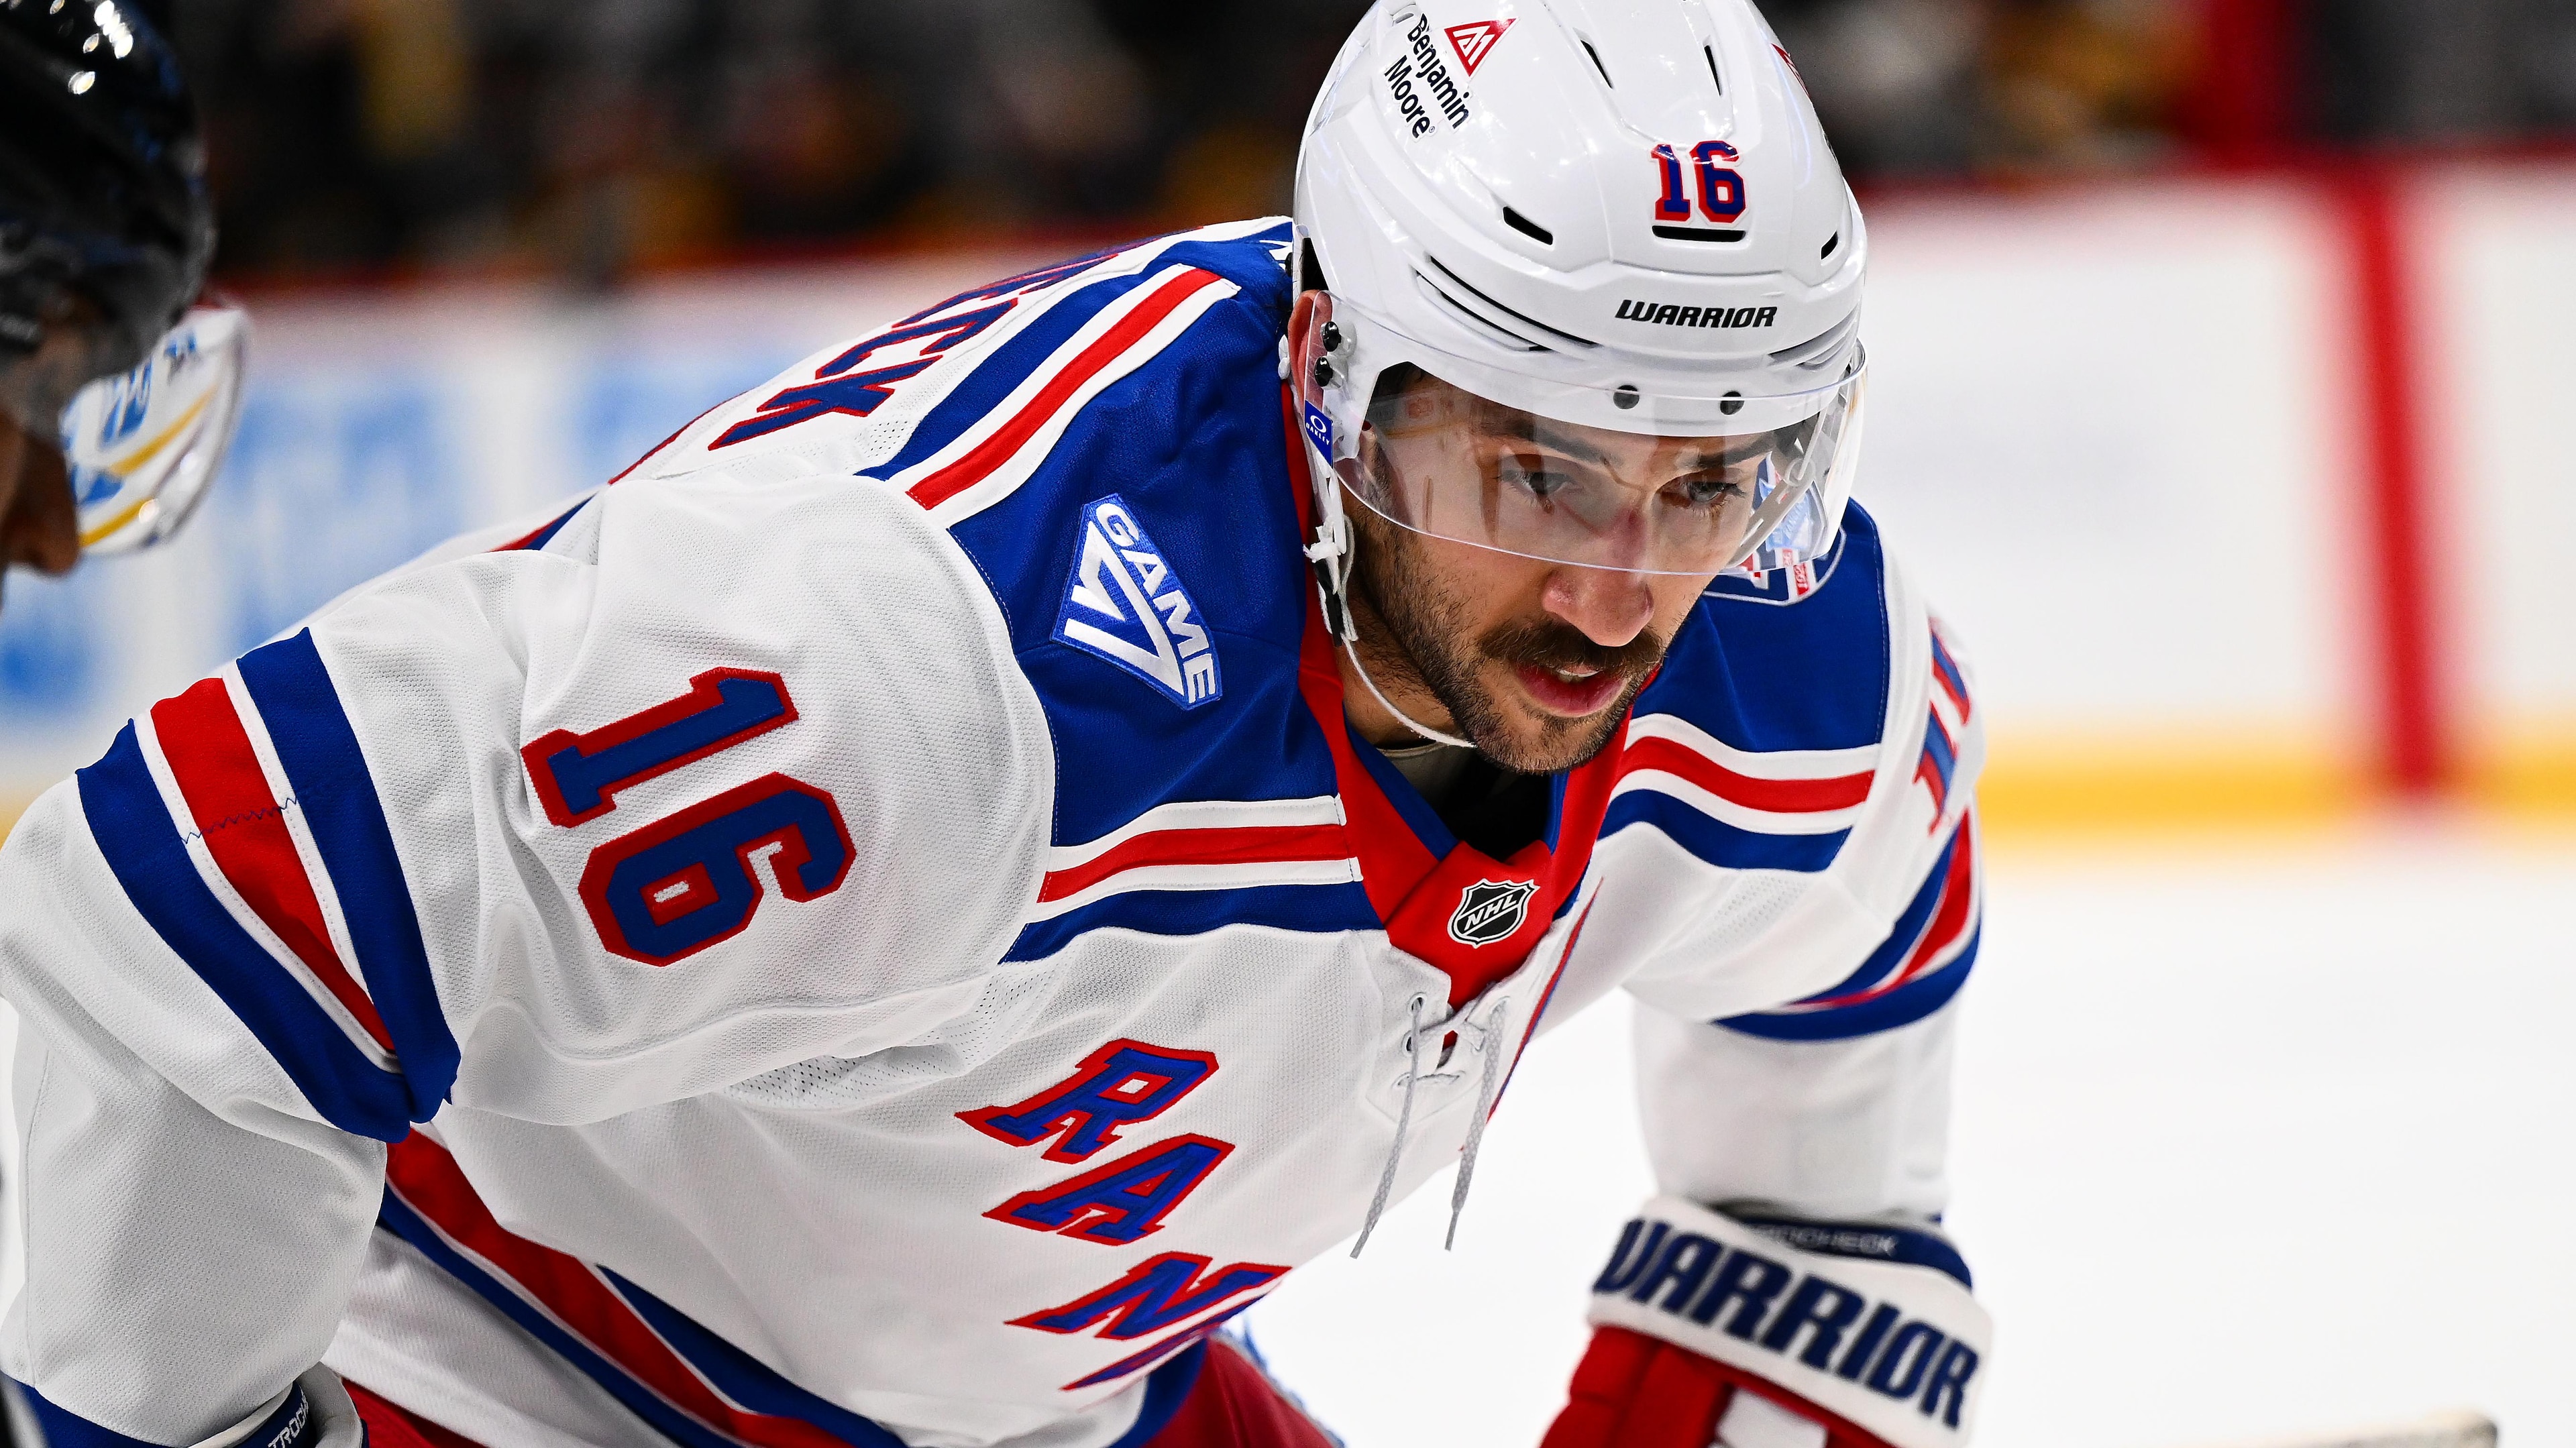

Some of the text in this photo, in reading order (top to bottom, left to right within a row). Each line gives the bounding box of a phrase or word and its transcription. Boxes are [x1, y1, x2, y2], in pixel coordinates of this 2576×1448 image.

[1407, 13, 1470, 129] Benjamin
[1650, 140, 1746, 223] 16
[1615, 299, 1778, 328] WARRIOR
[1305, 422, 1330, 446] OAKLEY
[1095, 502, 1216, 704] GAME
[520, 666, 857, 967] 16
[1464, 893, 1519, 931] NHL
[954, 1038, 1293, 1391] RAN
